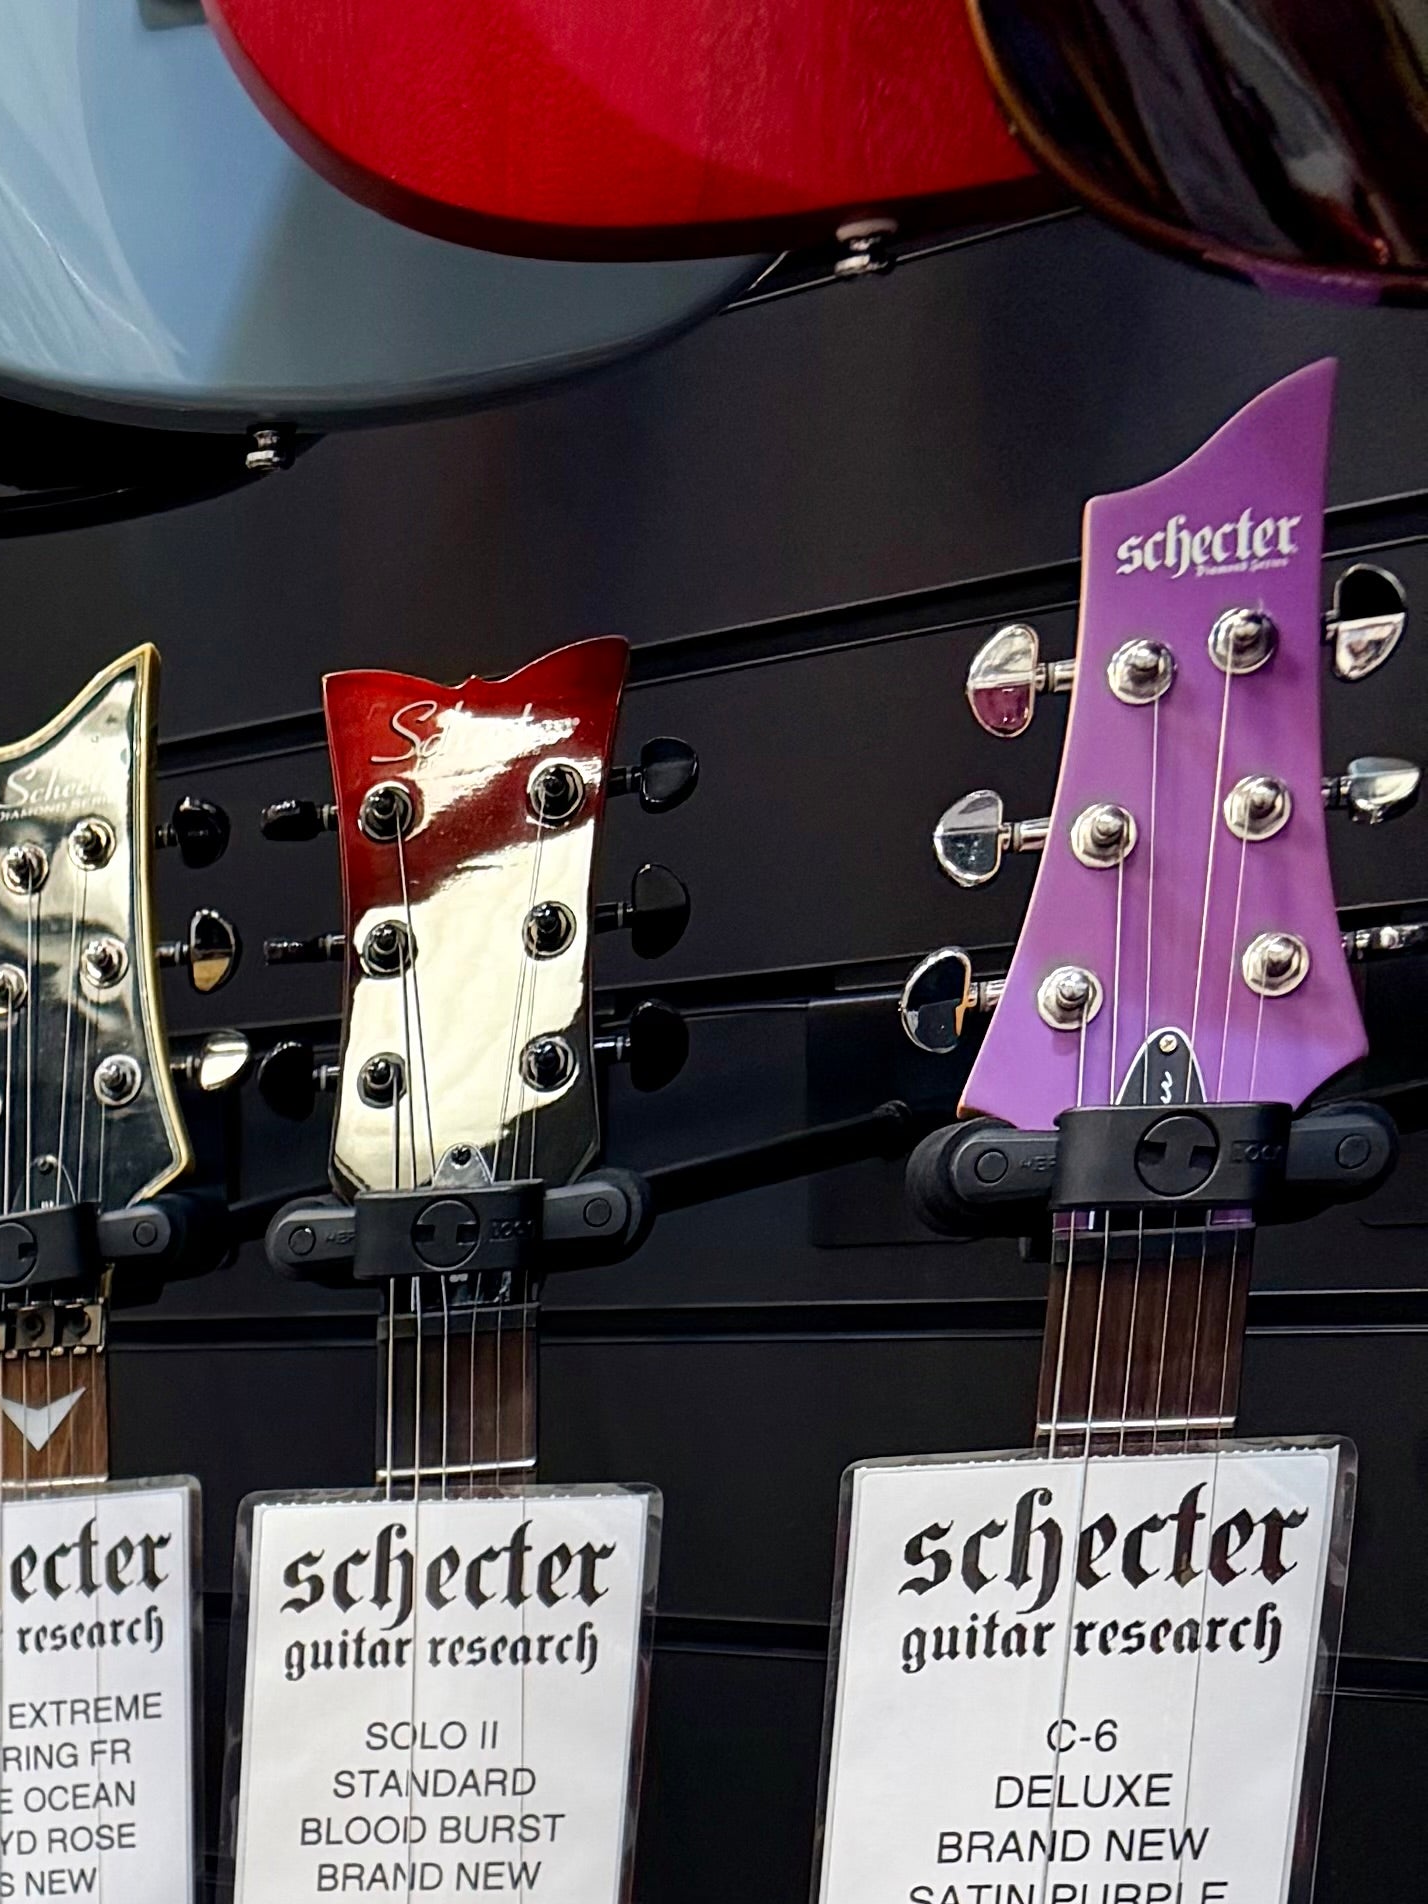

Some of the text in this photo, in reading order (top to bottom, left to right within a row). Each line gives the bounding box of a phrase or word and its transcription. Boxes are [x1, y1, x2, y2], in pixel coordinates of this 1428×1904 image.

[1115, 507, 1302, 580] schecter
[899, 1482, 1310, 1615] schecter
[280, 1519, 617, 1631] schecter
[17, 1605, 164, 1653] research
[901, 1602, 1282, 1674] guitar research
[285, 1621, 599, 1682] guitar research
[8, 1692, 162, 1730] EXTREME
[91, 1739, 131, 1766] FR
[365, 1720, 499, 1751] SOLO II
[1046, 1719, 1119, 1753] C-6
[24, 1780, 136, 1813] OCEAN
[333, 1768, 537, 1799] STANDARD
[994, 1773, 1173, 1809] DELUXE
[48, 1823, 137, 1854] ROSE
[300, 1814, 566, 1846] BLOOD BURST
[937, 1827, 1210, 1864] BRAND NEW
[25, 1867, 97, 1896] NEW
[317, 1861, 542, 1892] BRAND NEW
